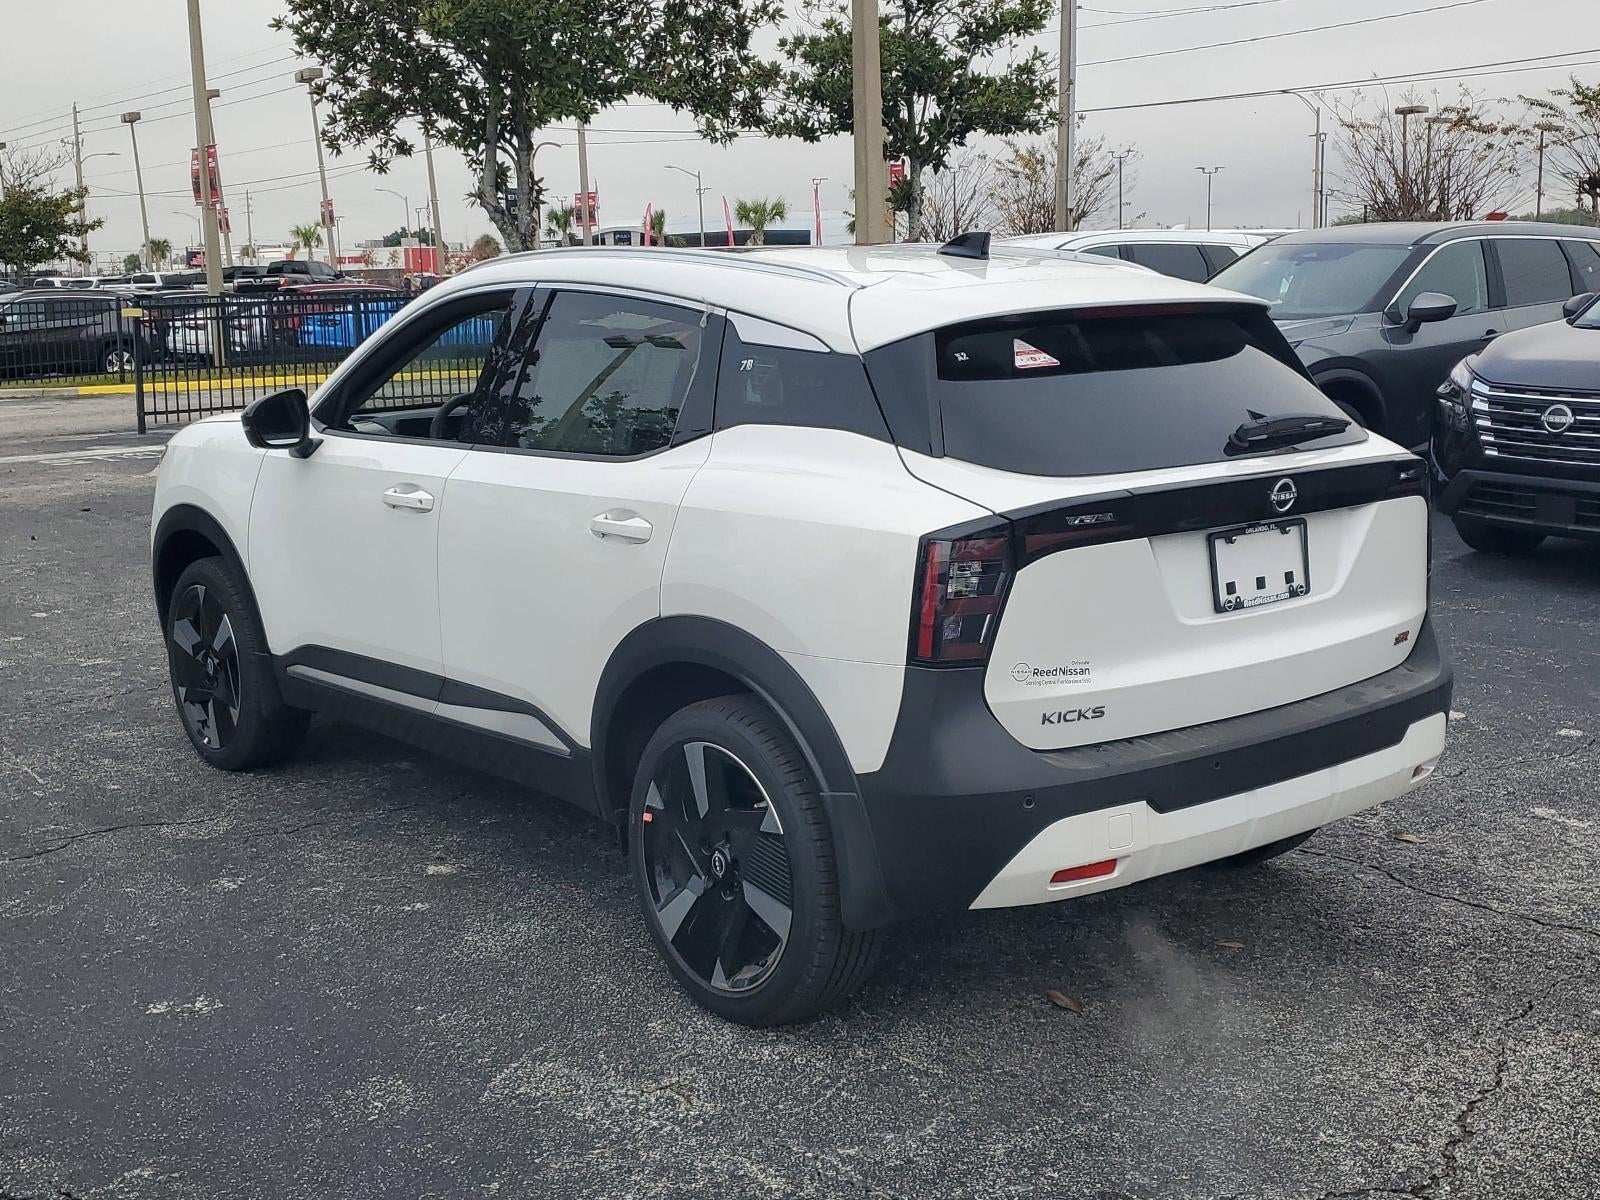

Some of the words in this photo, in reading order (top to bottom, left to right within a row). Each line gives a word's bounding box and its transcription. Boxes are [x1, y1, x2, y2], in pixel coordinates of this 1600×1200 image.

[1541, 414, 1575, 424] NISSAN
[1271, 492, 1297, 500] NISSAN
[1032, 666, 1058, 677] Reed
[1058, 665, 1091, 677] Nissan
[1041, 705, 1106, 726] KICKS
